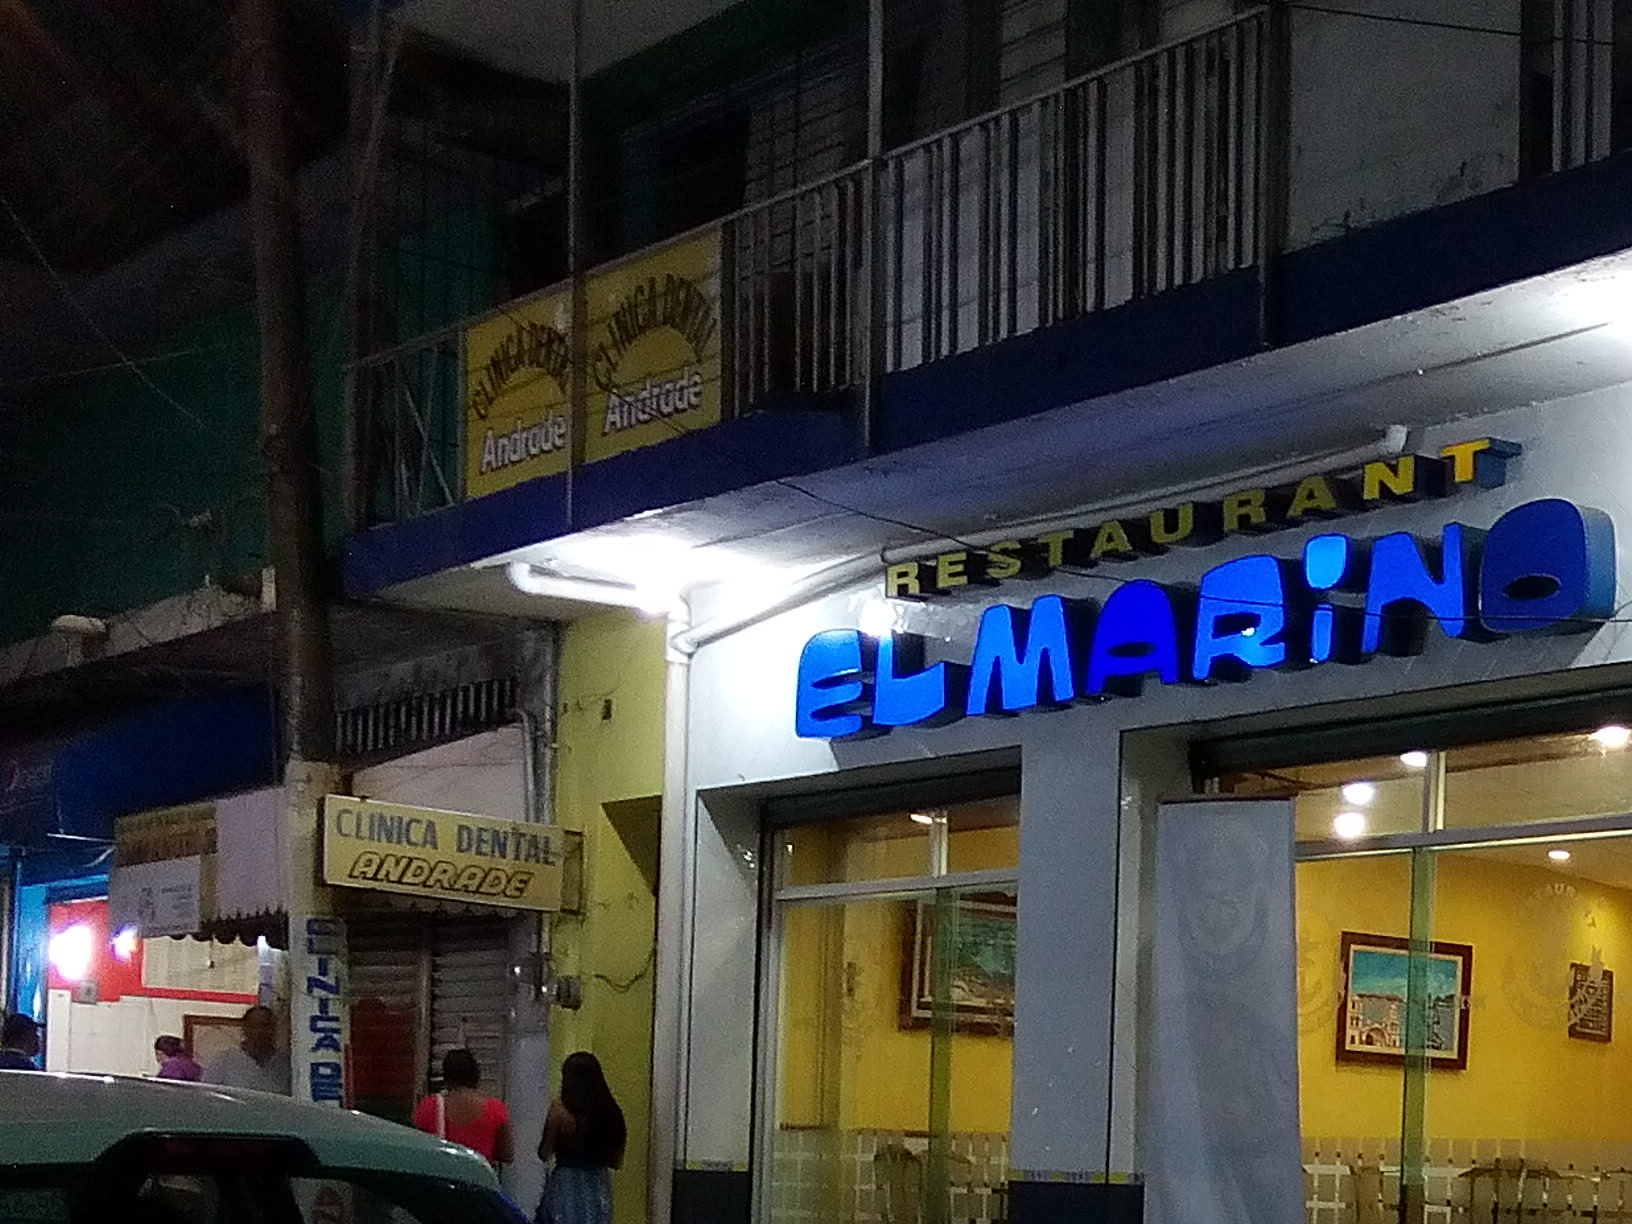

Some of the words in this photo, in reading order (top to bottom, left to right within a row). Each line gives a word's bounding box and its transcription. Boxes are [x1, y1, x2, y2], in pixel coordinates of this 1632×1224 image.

[602, 370, 703, 436] Andrade
[479, 412, 567, 476] Andrade
[886, 440, 1500, 598] RESTAURANT
[795, 624, 948, 738] EL
[336, 808, 438, 851] CLINICA
[456, 824, 556, 867] DENTAL
[348, 850, 534, 899] ANDRADE
[306, 917, 342, 1053] CLINICA
